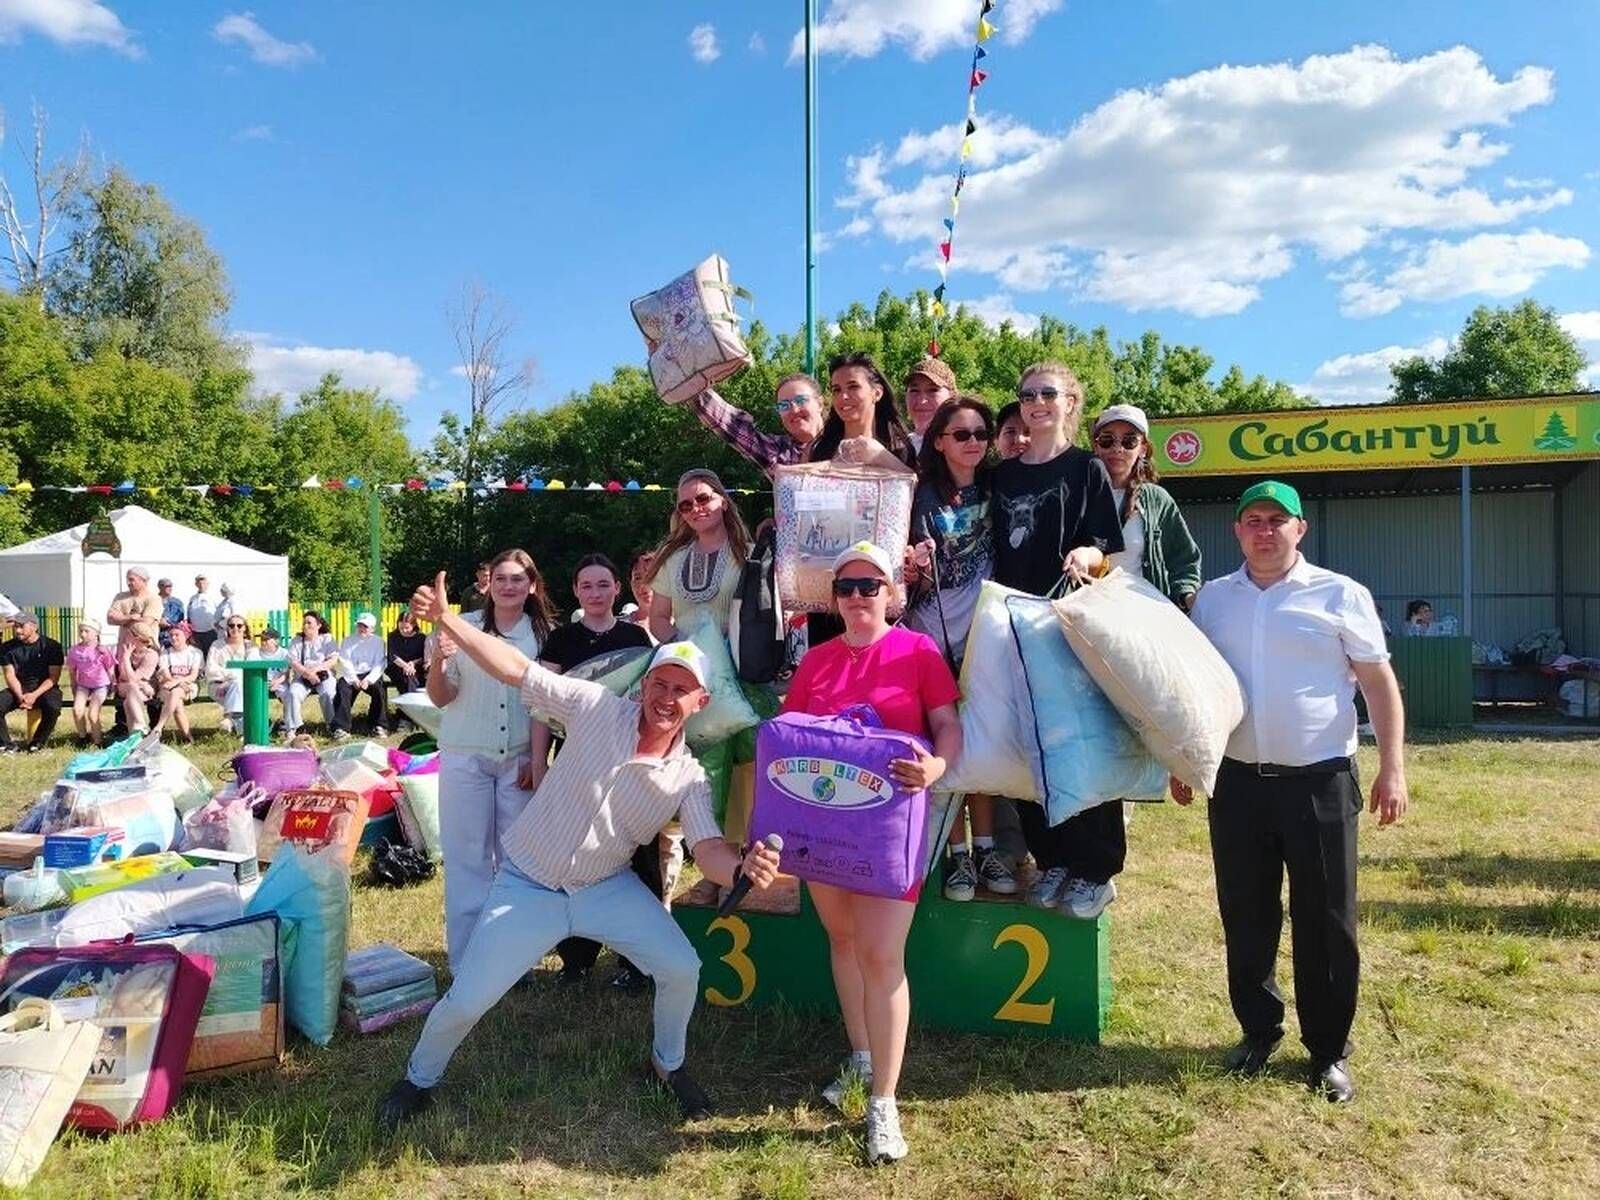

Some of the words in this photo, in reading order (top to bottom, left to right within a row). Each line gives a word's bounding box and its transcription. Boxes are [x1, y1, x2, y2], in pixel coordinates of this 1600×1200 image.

[1228, 416, 1501, 461] Сабантуй
[704, 914, 757, 1007] 3
[993, 924, 1055, 1024] 2
